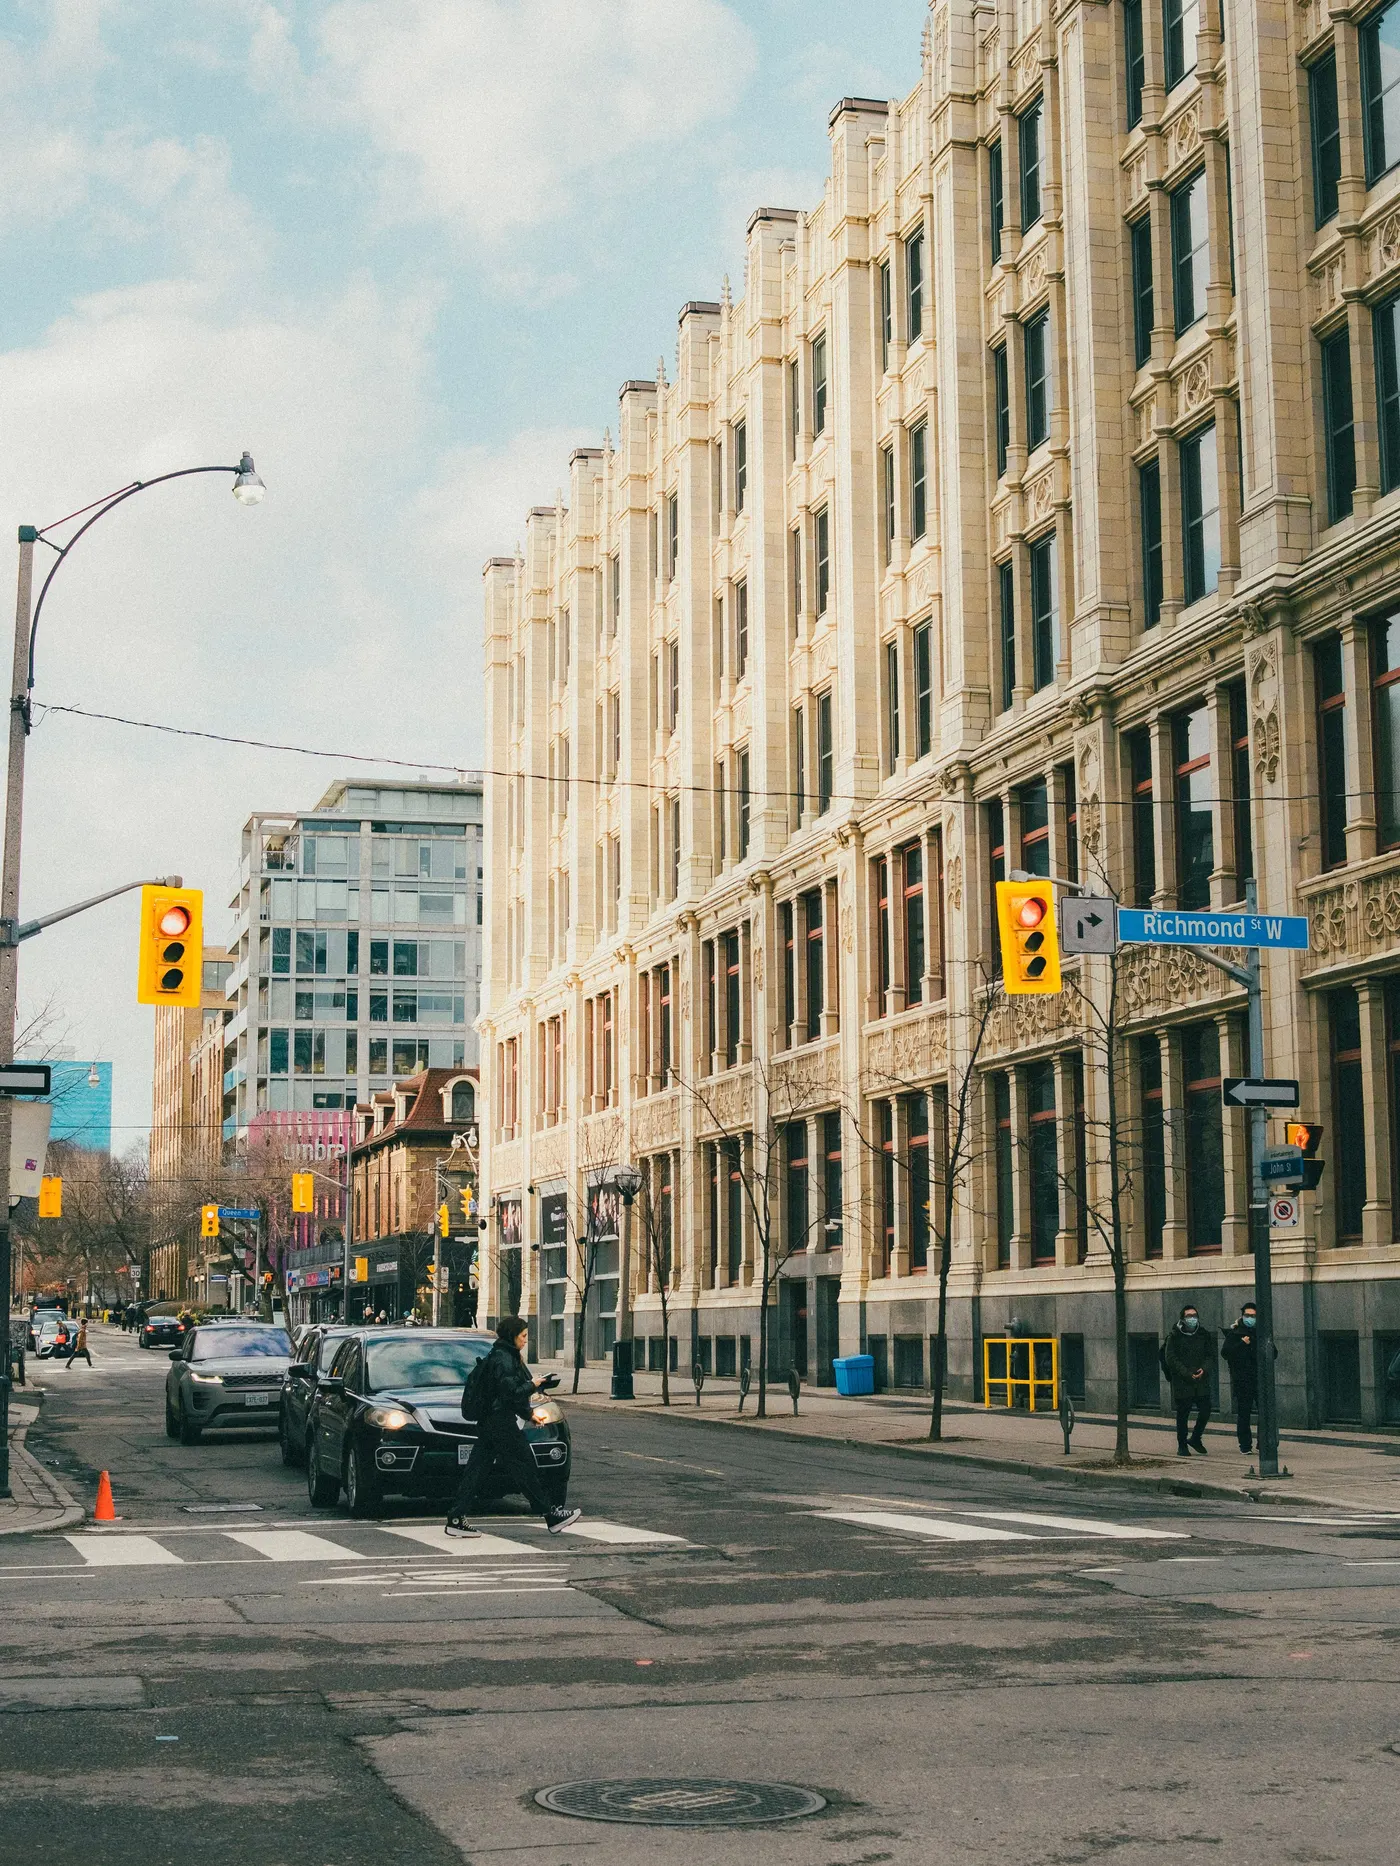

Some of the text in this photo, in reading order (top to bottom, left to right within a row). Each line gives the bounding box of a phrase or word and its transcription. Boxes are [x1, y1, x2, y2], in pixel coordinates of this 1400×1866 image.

[1143, 913, 1283, 940] Richmond St W
[284, 1138, 346, 1161] umbra
[1270, 1162, 1285, 1174] John
[222, 1208, 242, 1216] Queen
